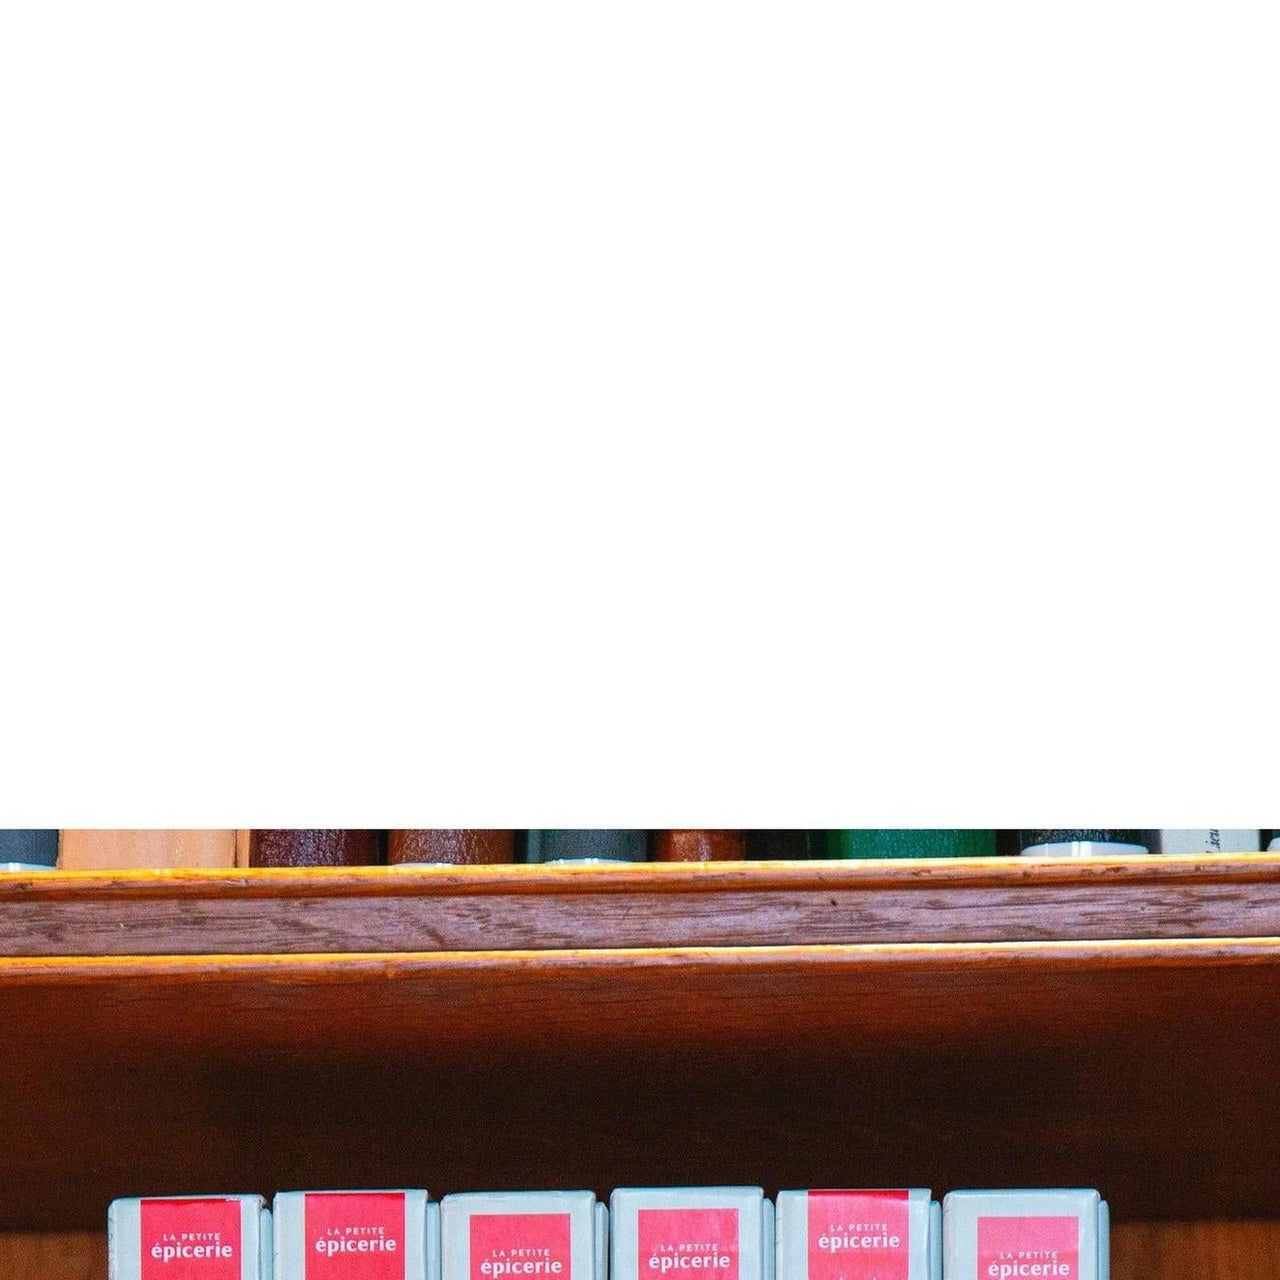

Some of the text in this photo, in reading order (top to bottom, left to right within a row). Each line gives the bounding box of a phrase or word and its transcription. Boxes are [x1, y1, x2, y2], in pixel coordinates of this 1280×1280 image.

[163, 1233, 220, 1241] LA PETITE
[151, 1241, 233, 1259] épicerie
[648, 1252, 730, 1271] épicerie
